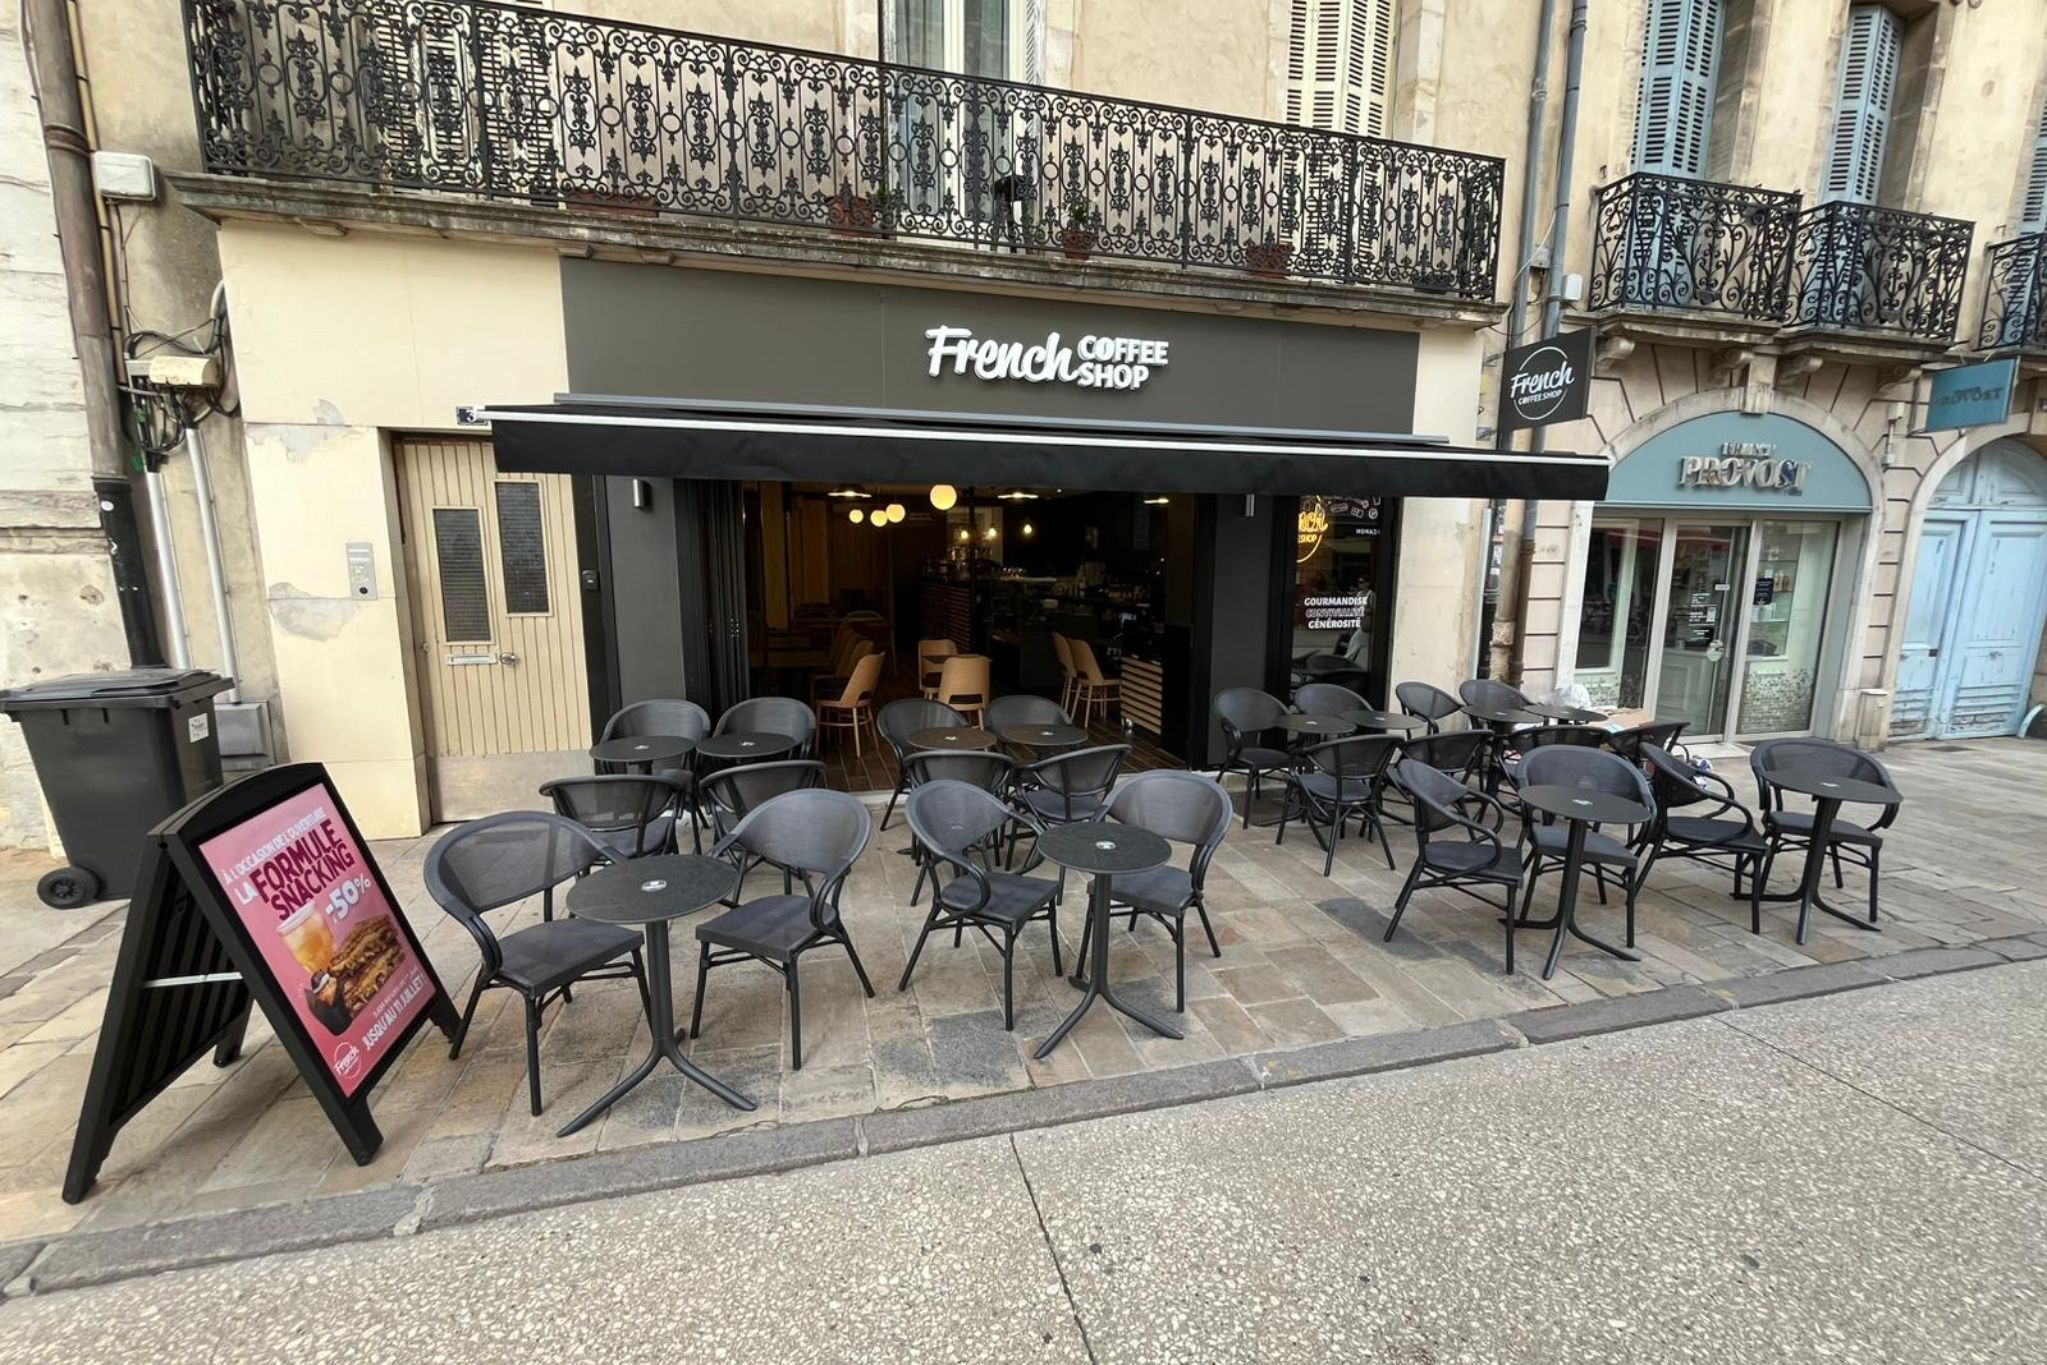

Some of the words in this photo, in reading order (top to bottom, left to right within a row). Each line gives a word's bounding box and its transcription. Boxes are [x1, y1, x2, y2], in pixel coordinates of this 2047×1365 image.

[925, 325, 1080, 382] French
[1077, 335, 1169, 367] COFFEE
[1077, 362, 1149, 390] SHOP
[1510, 360, 1575, 398] French
[1518, 393, 1543, 405] COFFEE
[1542, 389, 1563, 400] SHOP
[1677, 455, 1812, 490] PROVOST
[1308, 617, 1361, 629] GÉNÉROSITÉ
[234, 882, 258, 905] LA
[249, 819, 340, 904] FORMULE
[271, 843, 355, 921] SNACKING
[325, 874, 371, 921] -50%
